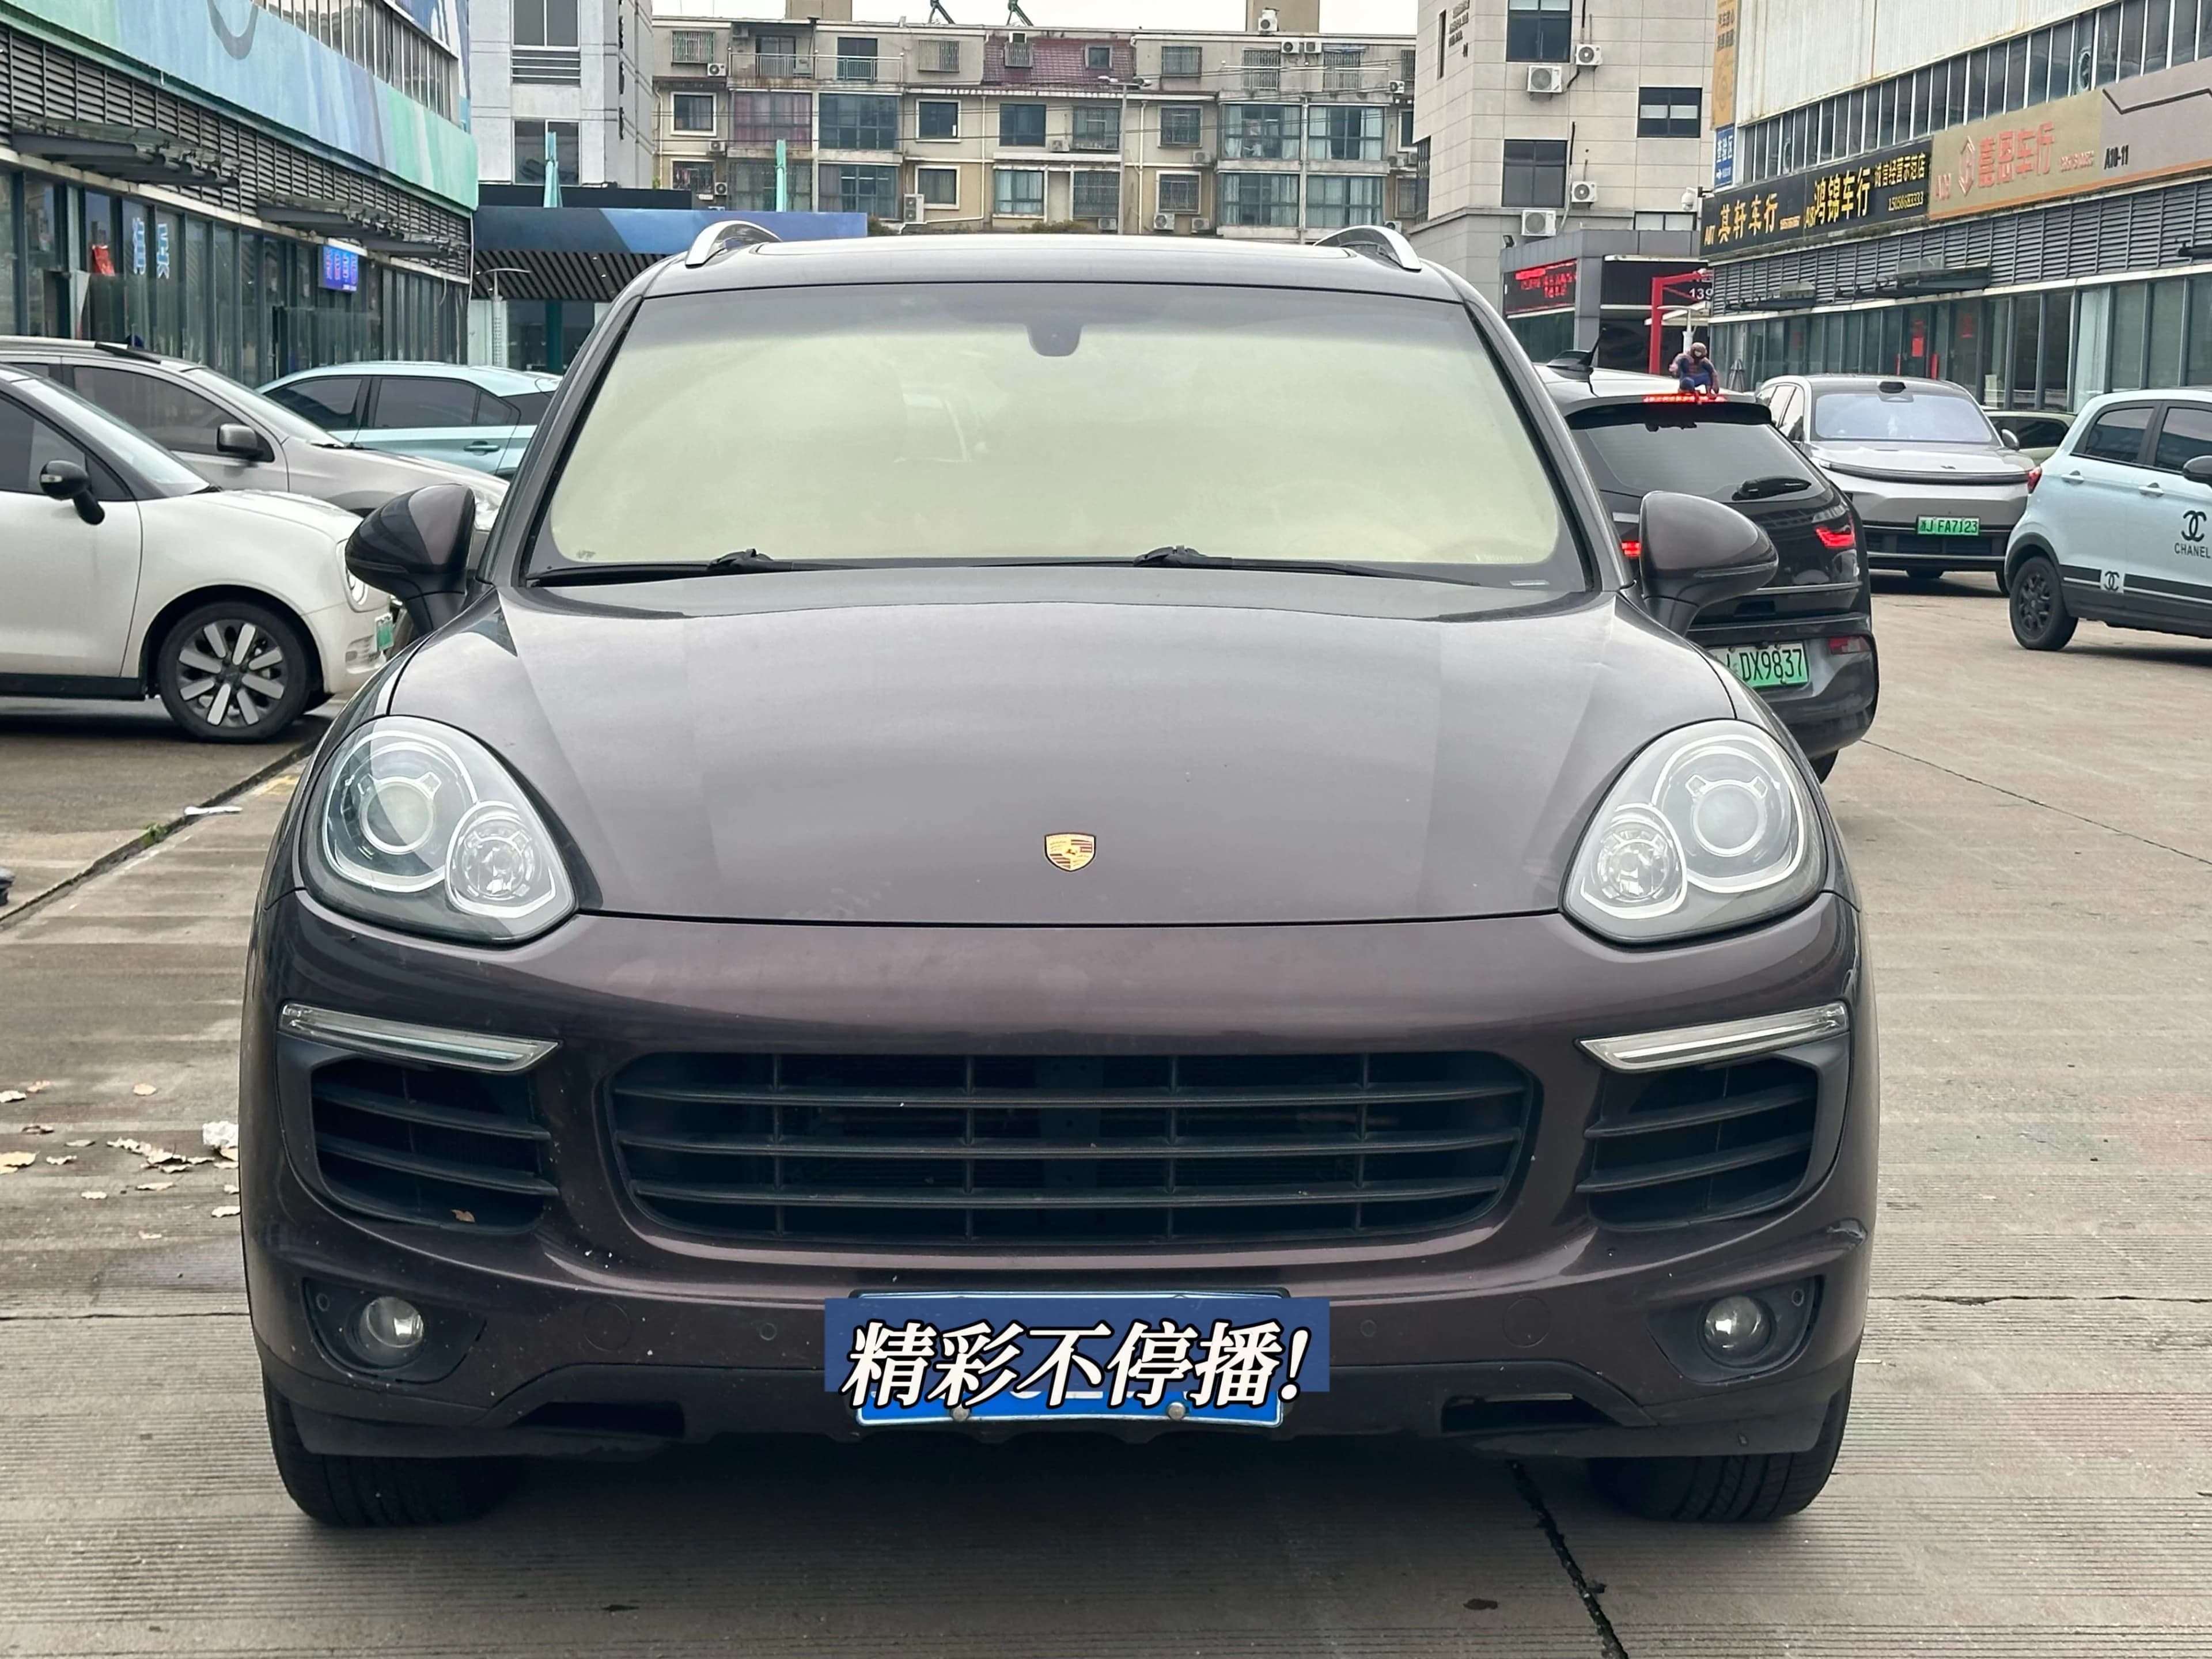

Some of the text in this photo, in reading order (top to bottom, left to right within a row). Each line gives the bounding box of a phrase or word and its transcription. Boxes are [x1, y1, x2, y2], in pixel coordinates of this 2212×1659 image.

[1874, 151, 1926, 187] 诚信经营示范店
[1814, 166, 1871, 225] 鸿锦车行
[2174, 542, 2211, 558] CHANEL
